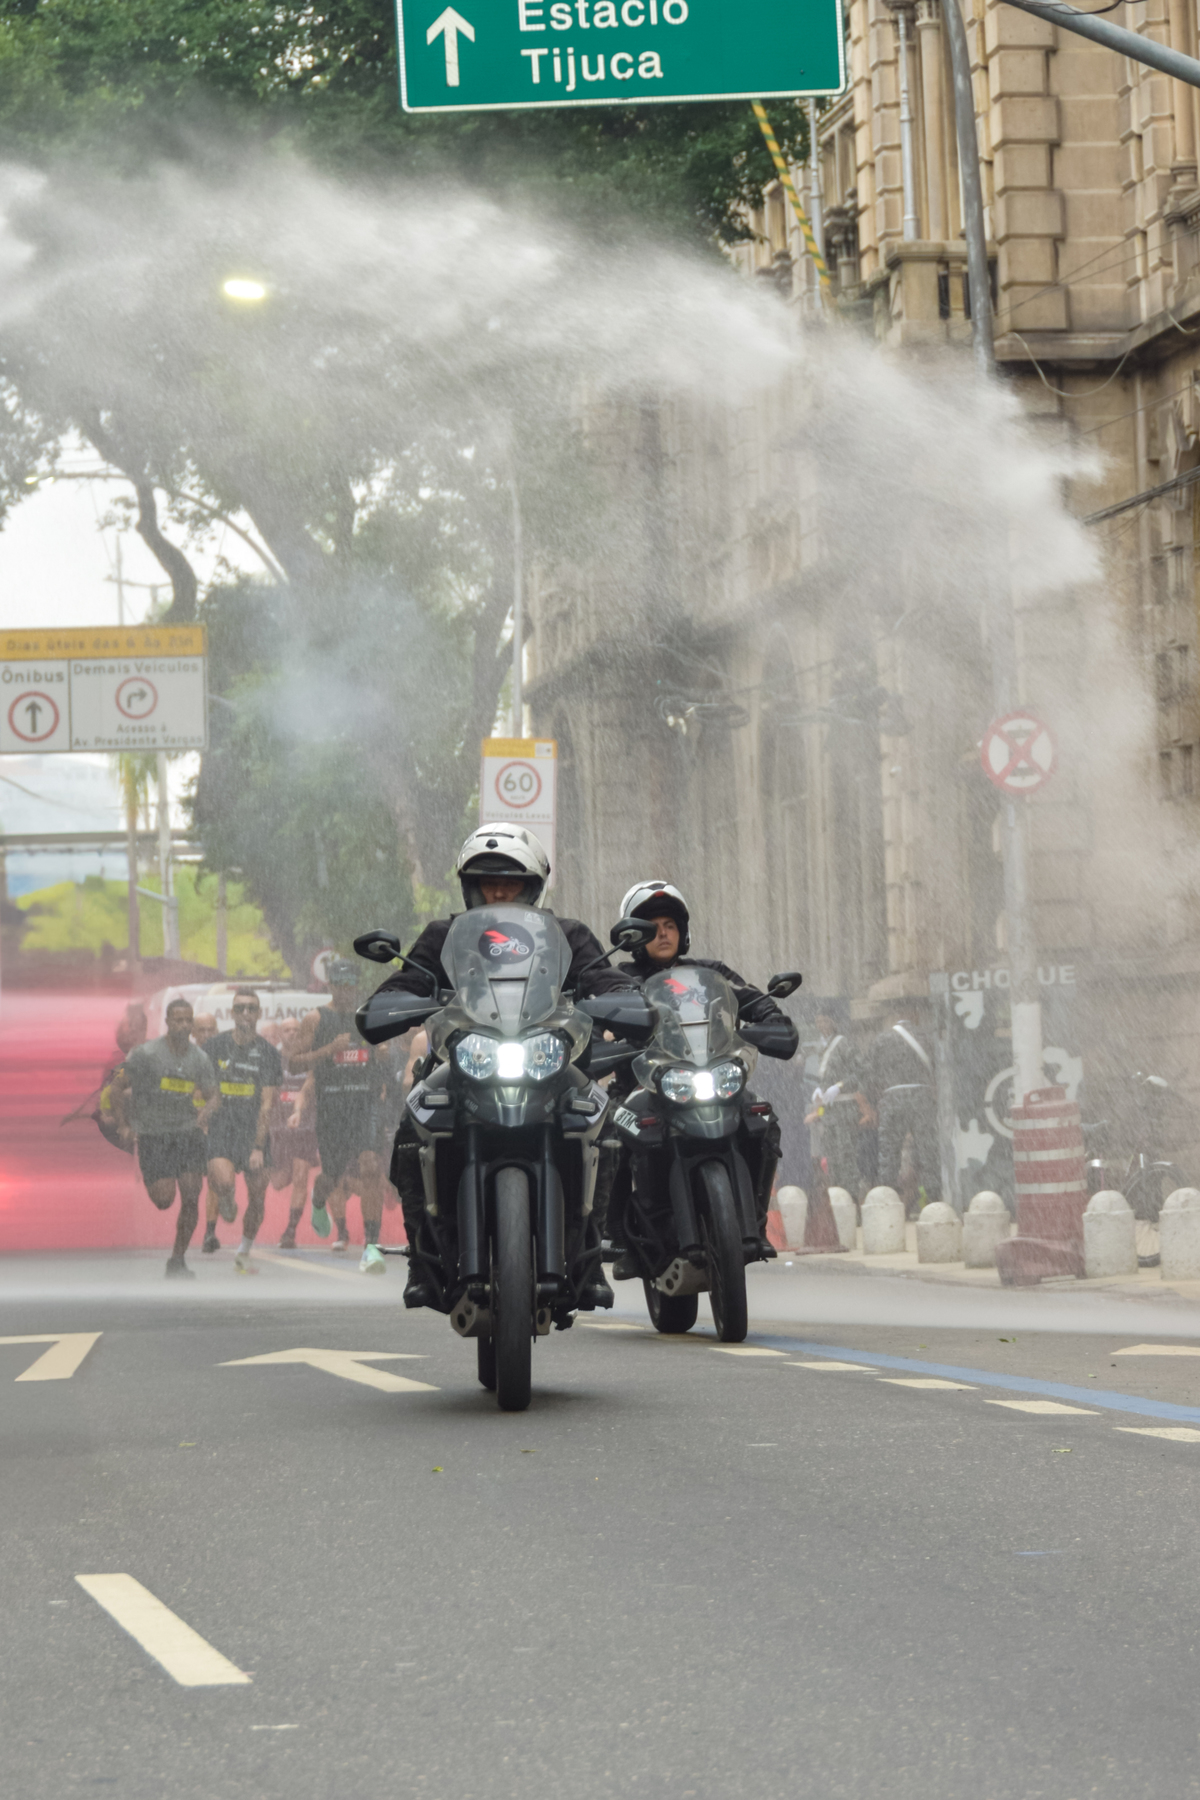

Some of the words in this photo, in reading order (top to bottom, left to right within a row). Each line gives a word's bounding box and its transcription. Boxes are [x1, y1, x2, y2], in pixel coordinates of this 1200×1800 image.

[520, 47, 664, 92] Tijuca
[2, 665, 64, 684] Ônibus
[73, 663, 130, 676] Demais
[116, 723, 156, 734] Acesso
[94, 735, 157, 747] Presidente
[162, 734, 203, 747] Vargas
[503, 772, 534, 793] 60
[950, 964, 1077, 992] CHOUE
[616, 1110, 637, 1129] BTM
